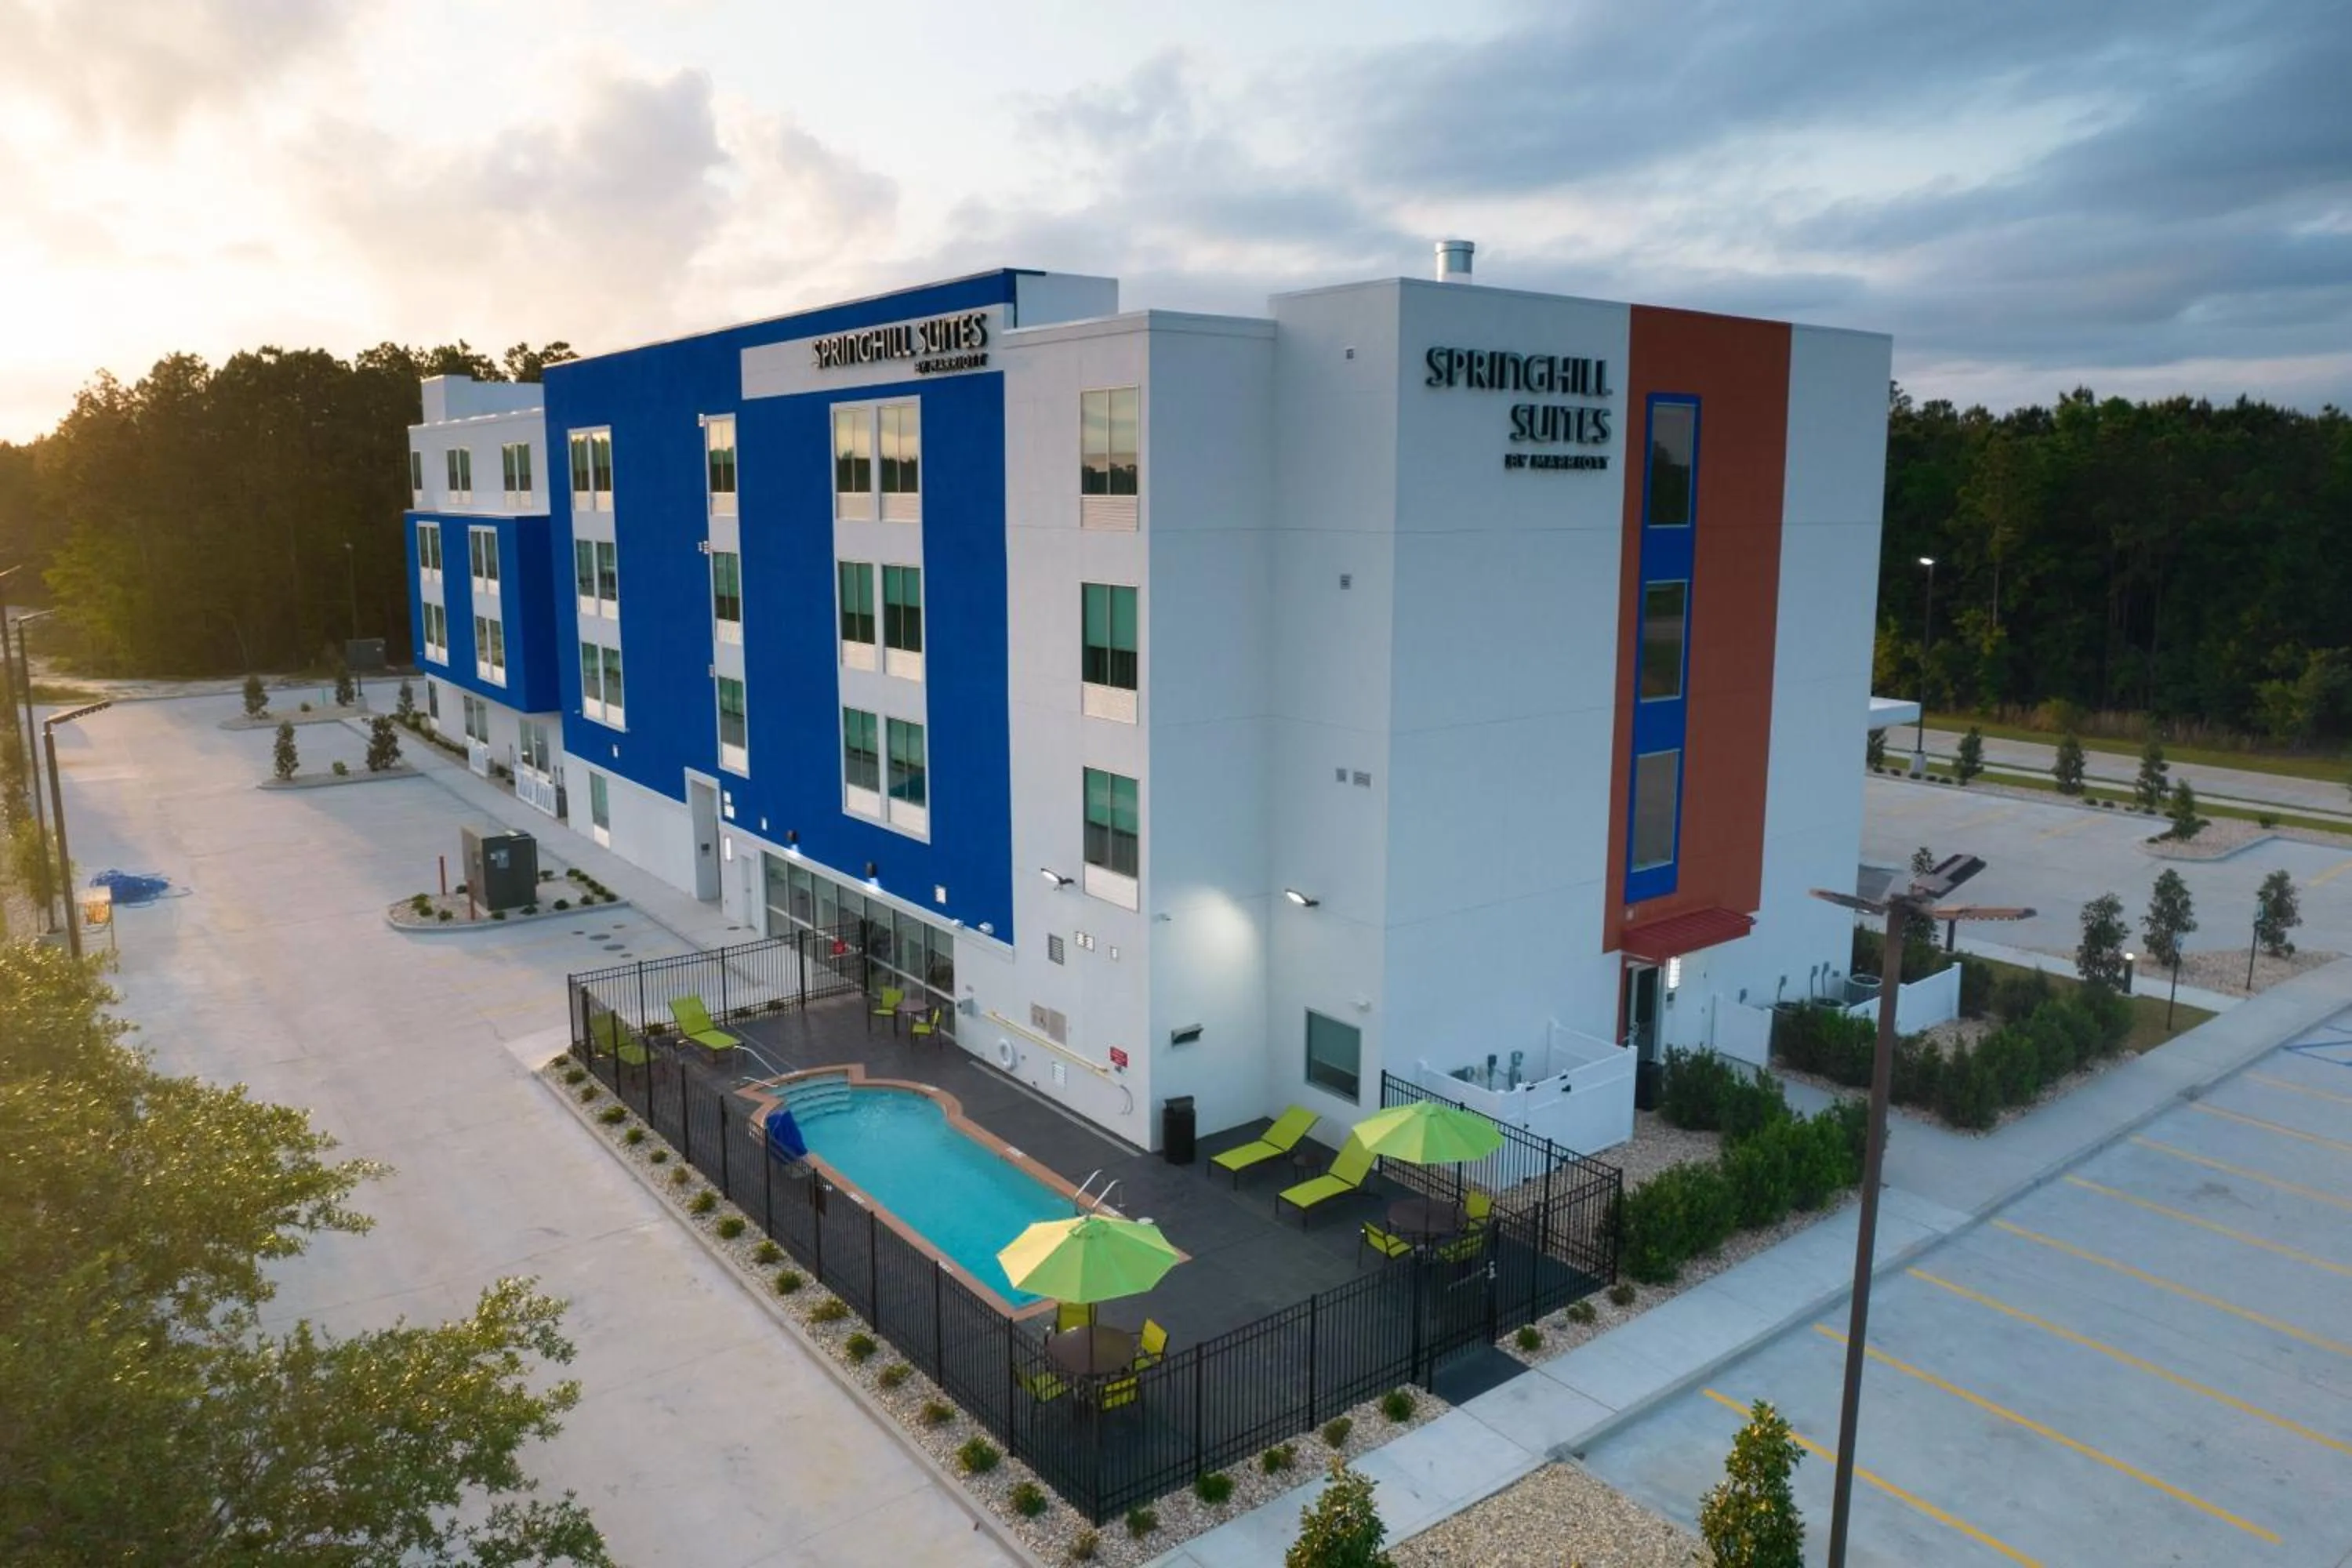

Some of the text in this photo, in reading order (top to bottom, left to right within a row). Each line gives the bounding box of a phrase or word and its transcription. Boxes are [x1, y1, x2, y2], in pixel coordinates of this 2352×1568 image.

[814, 313, 988, 368] SPRINGHILL SUITES
[1425, 347, 1613, 396] SPRINGHILL
[1509, 404, 1611, 444] SUITES
[1504, 453, 1610, 470] BY MARRIOTT
